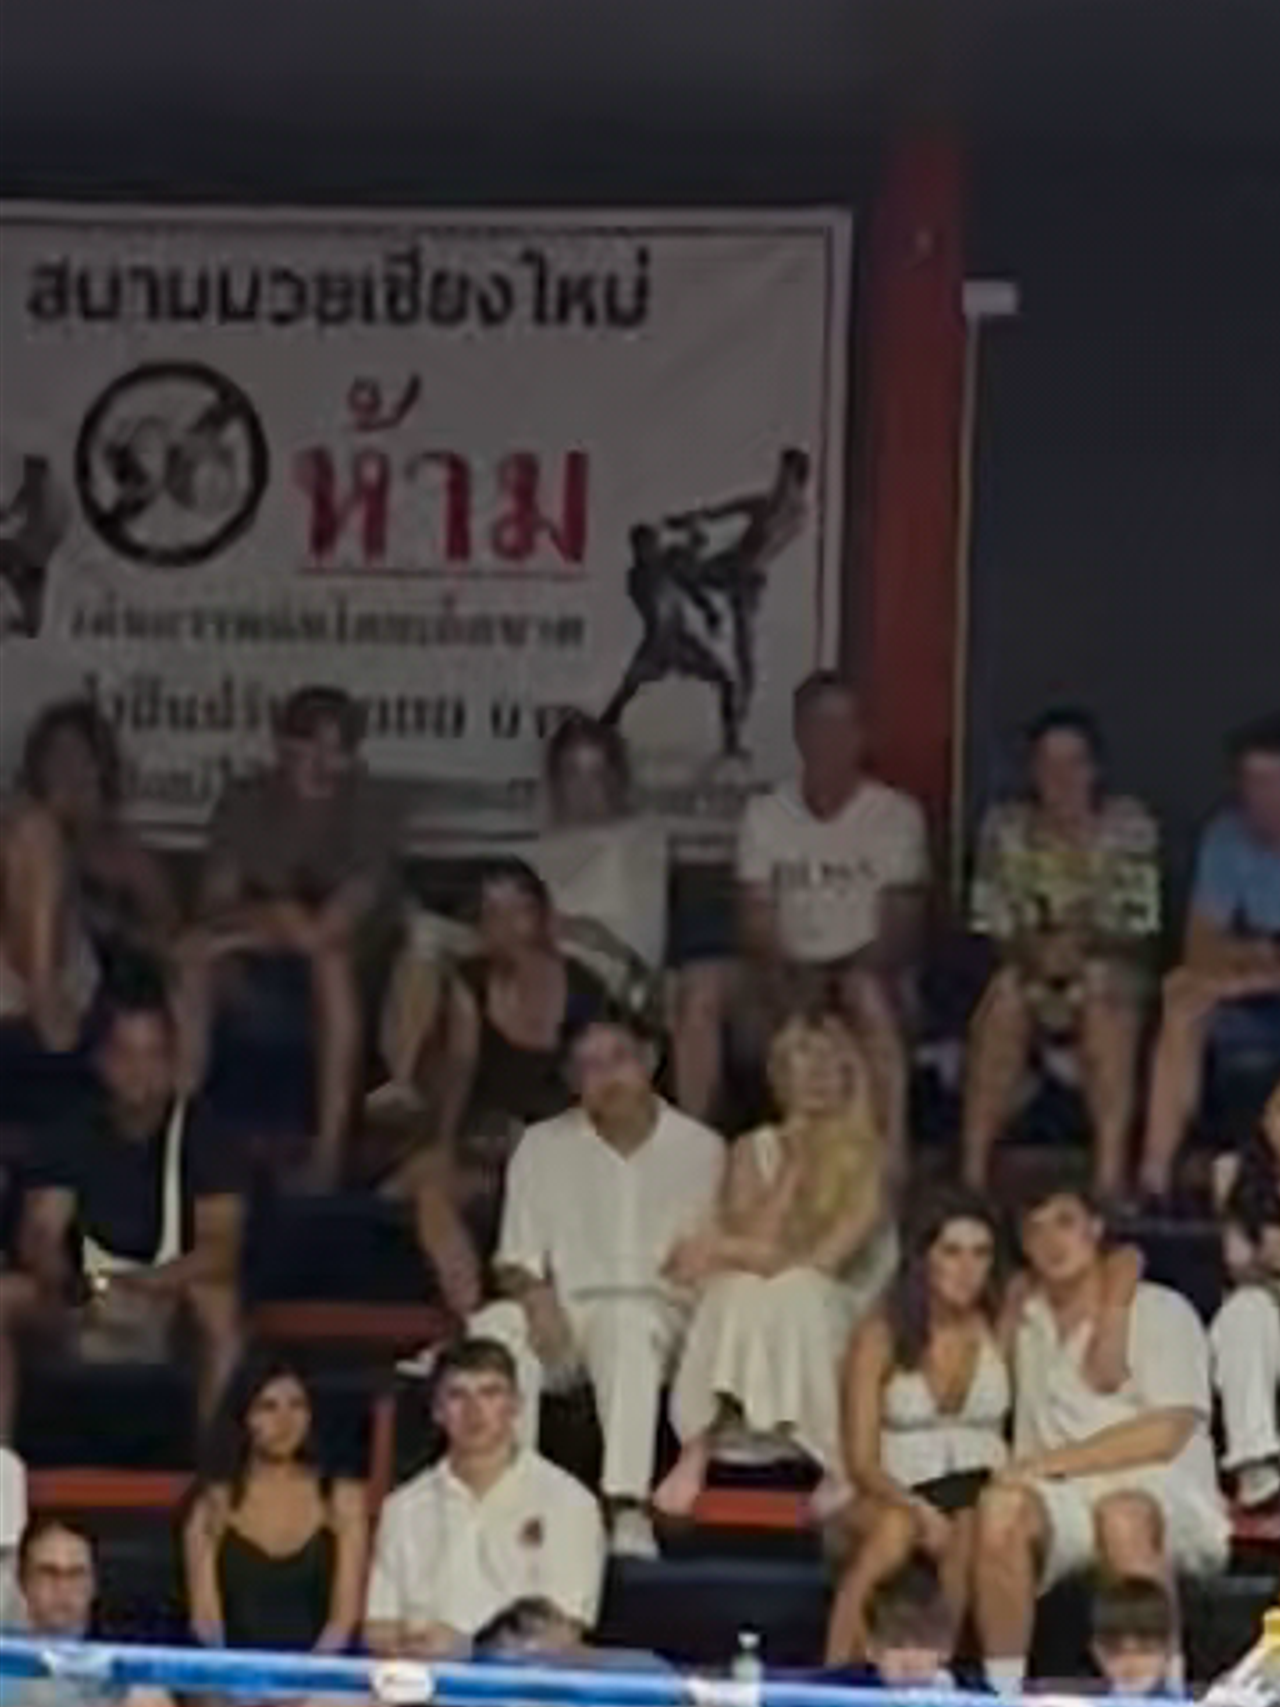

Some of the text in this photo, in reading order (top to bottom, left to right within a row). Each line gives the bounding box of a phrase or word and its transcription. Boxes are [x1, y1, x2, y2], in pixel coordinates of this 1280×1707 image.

[26, 245, 651, 329] สนามมวยเชียงใหม่
[292, 373, 589, 565] ห้าม
